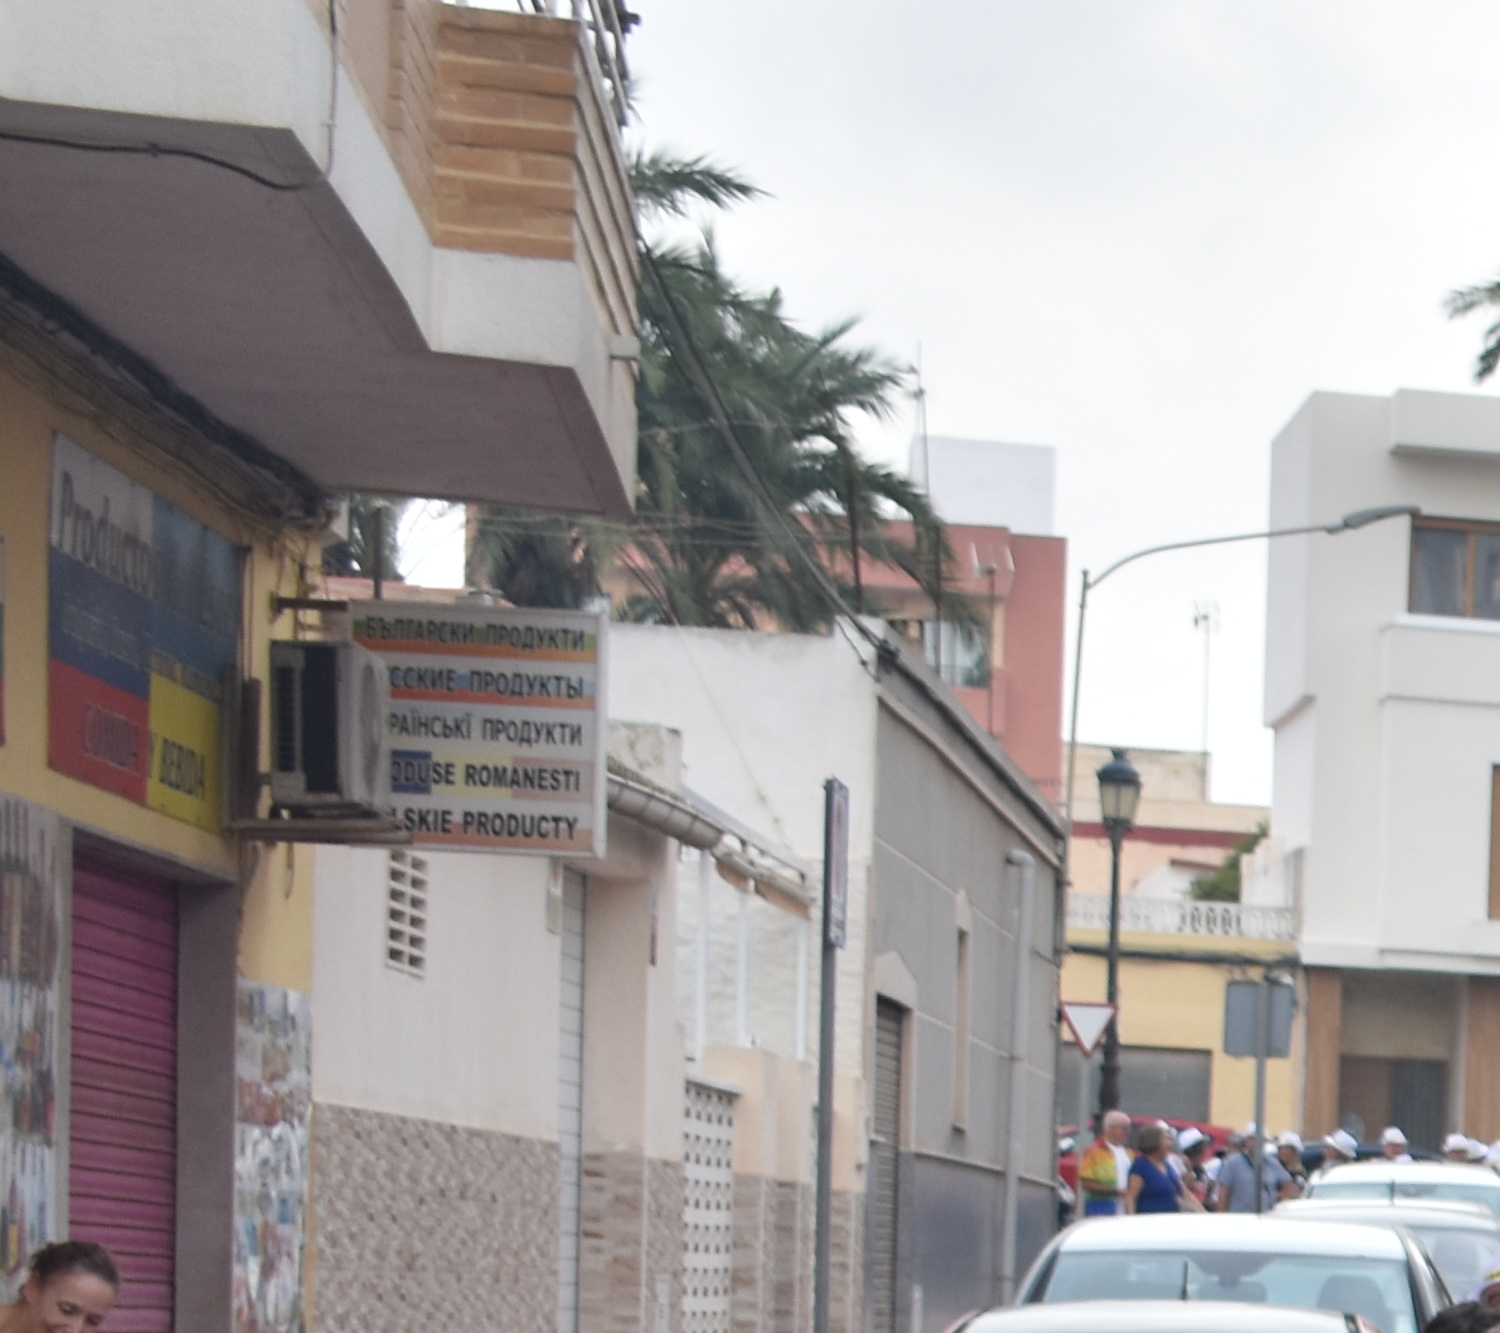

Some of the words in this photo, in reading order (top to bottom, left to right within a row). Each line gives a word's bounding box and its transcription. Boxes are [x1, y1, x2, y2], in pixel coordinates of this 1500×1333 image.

[365, 615, 475, 642] БЪЛГАРСКИ
[485, 623, 586, 651] ПРОДУКТИ
[388, 666, 457, 691] ССКИЕ
[469, 669, 584, 699] ПРОДУКТЫ
[482, 718, 583, 747] ПРОДУКТИ
[465, 765, 580, 792] ROMANESTI
[462, 811, 579, 840] PRODUCTY
